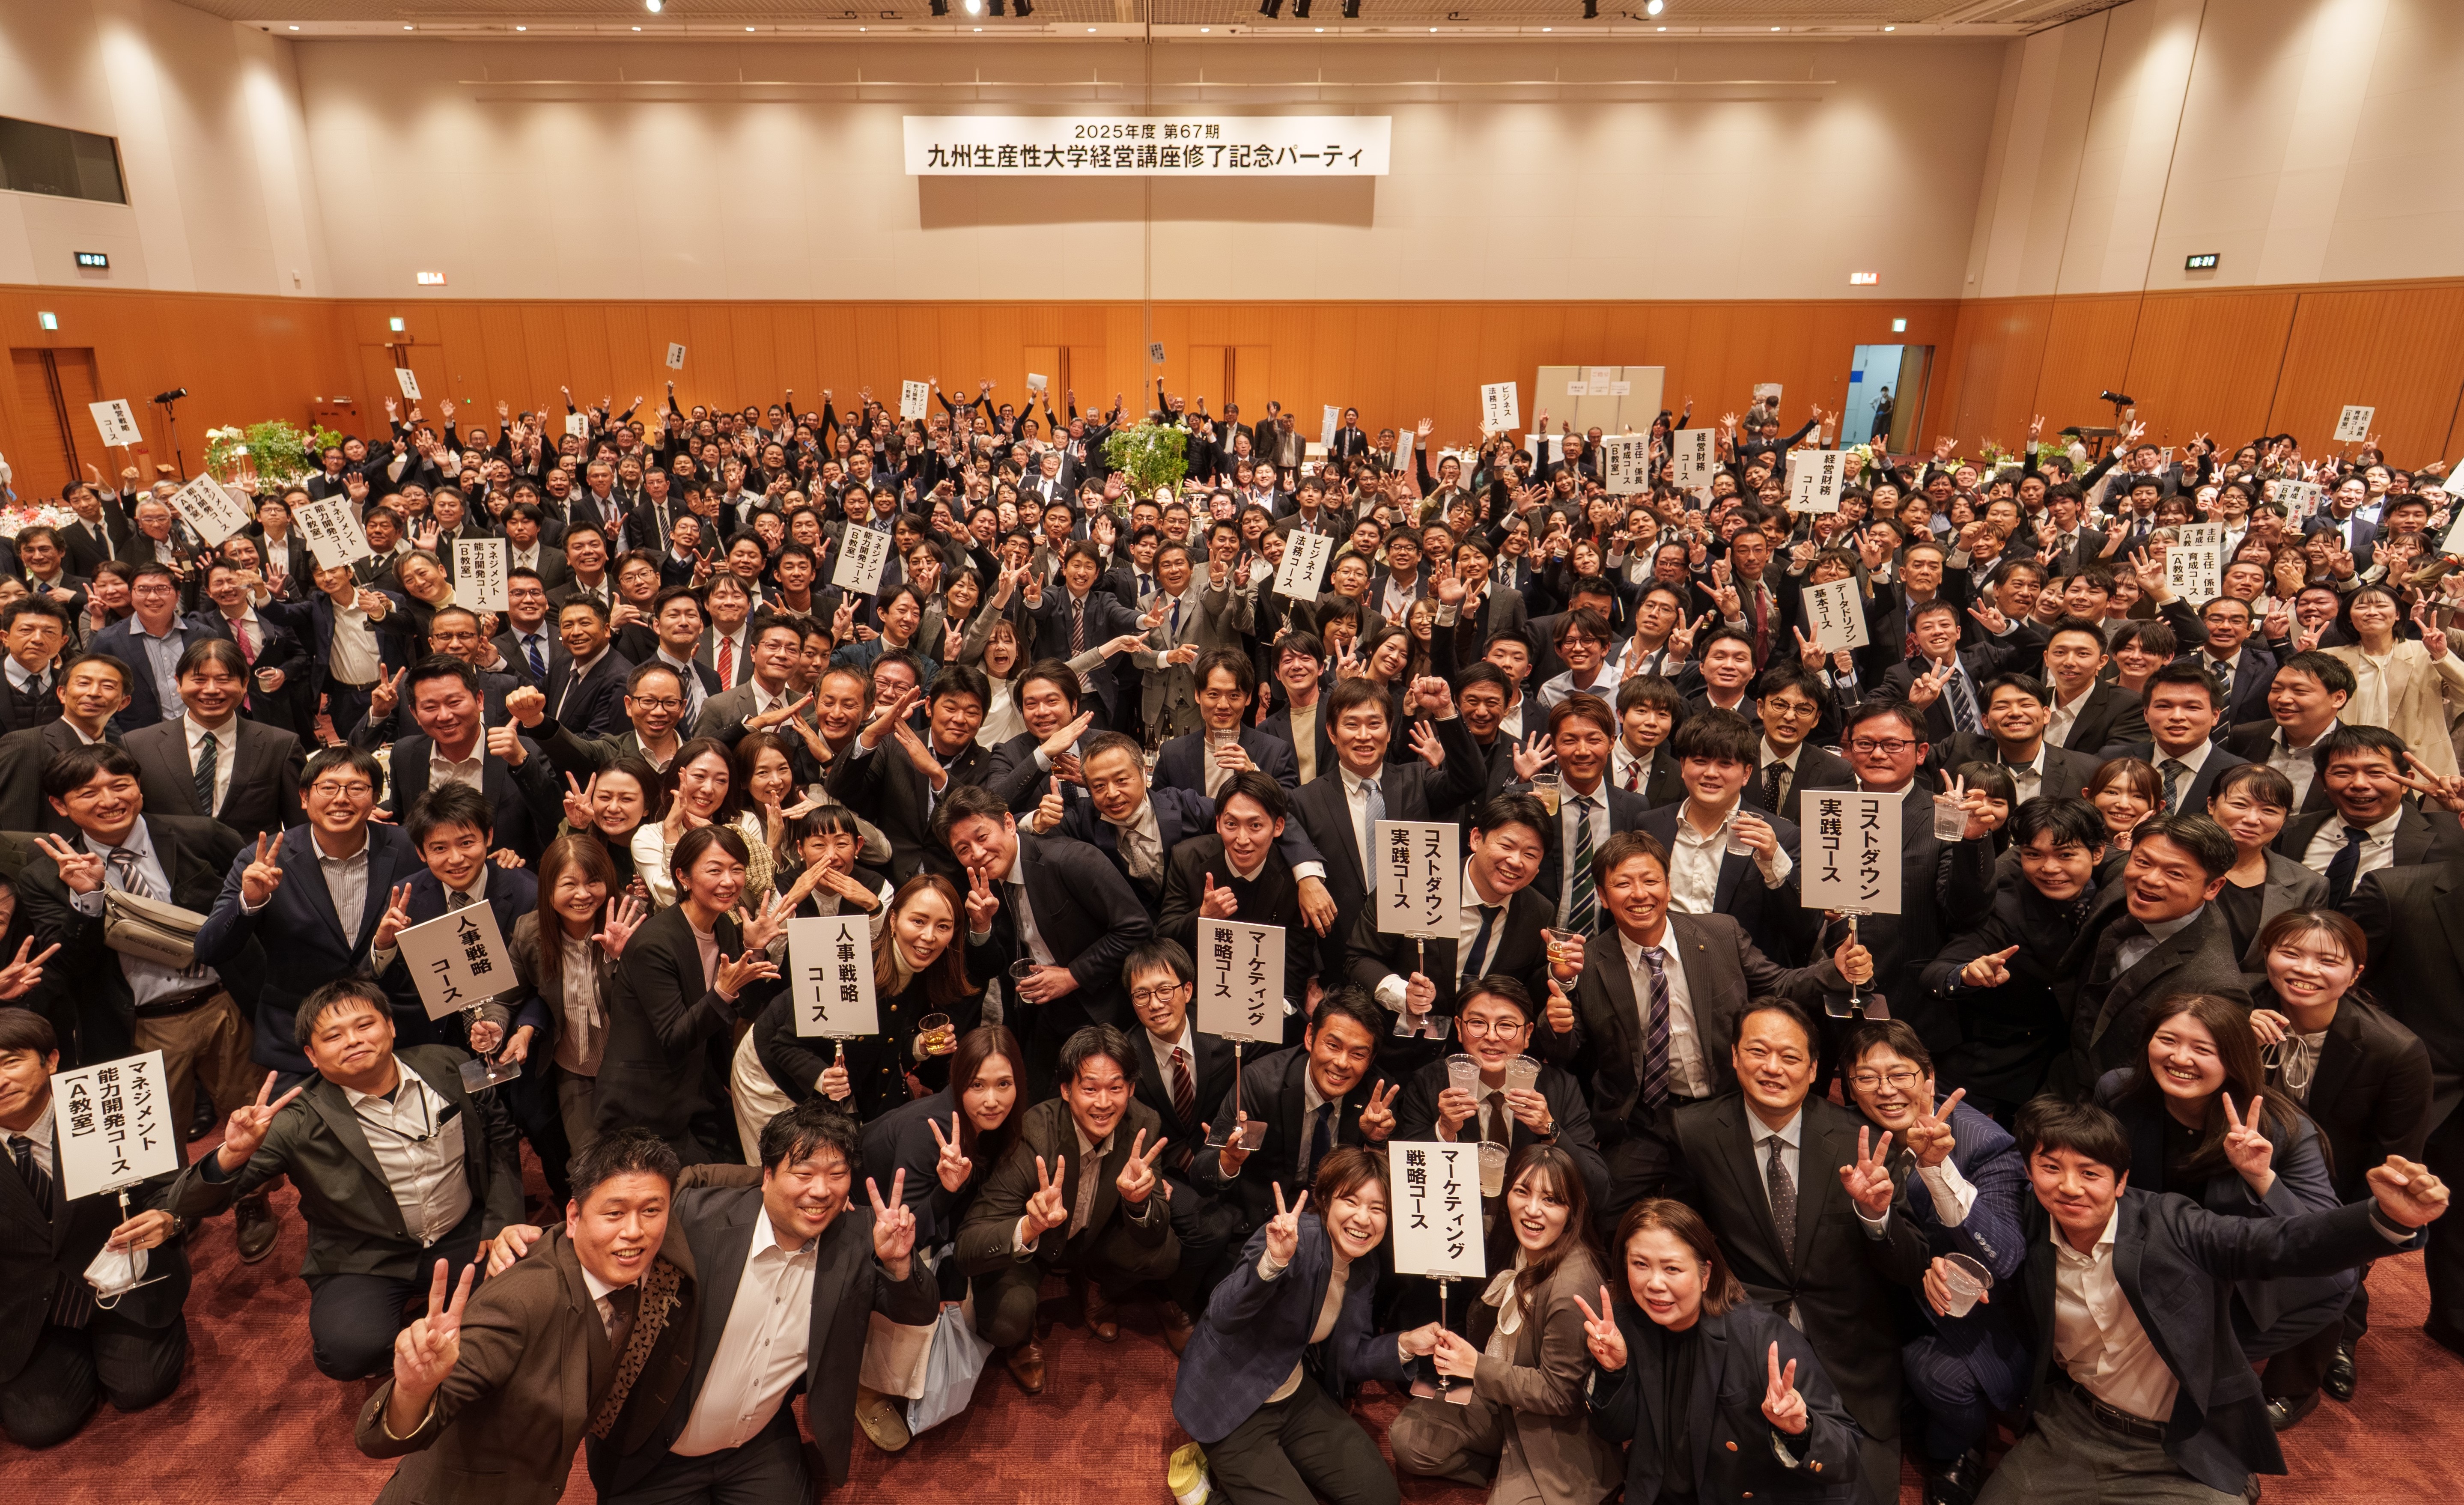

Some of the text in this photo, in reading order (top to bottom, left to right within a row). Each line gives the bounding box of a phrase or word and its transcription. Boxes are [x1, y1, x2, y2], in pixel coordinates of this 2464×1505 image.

[1075, 124, 1219, 139] 2025年度 第67期
[928, 144, 1363, 168] 九州生産性大学経営講座修了記念パーティ
[1489, 387, 1499, 425] 法務コース
[1502, 386, 1511, 416] ビジネス
[104, 420, 119, 440] コース
[1696, 432, 1706, 471] 経営財務
[1611, 444, 1620, 475] 【B教室】
[1623, 443, 1631, 484] 育成コース
[1635, 442, 1643, 484] 主任・係長
[1681, 454, 1689, 480] コース
[1820, 454, 1836, 495] 経営財務
[186, 487, 230, 531] 能力開発コース
[197, 480, 232, 518] マネジメント
[1800, 476, 1812, 504] コース
[300, 509, 324, 540] 【A教室】
[314, 504, 349, 557] 能力開発コース
[328, 501, 357, 545] マネジメント
[845, 527, 861, 558] 【B教室】
[2195, 529, 2204, 546] 育成
[459, 543, 471, 578] 【B教室】
[474, 542, 486, 605] 能力開発コース
[488, 543, 499, 596] マネジメント
[852, 531, 873, 584] 能力開発コース
[867, 535, 884, 580] マネジメント
[1283, 535, 1306, 587] 法務コース
[1303, 539, 1323, 581] ビジネス
[2172, 553, 2184, 585] 【A教室】
[2188, 552, 2199, 595] 育成コース
[2203, 552, 2214, 595] 主任・係長
[1814, 588, 1832, 629] 基本コース
[1835, 583, 1856, 642] データドリブン
[1820, 799, 1842, 882] 実践コース
[1859, 799, 1880, 900] コストダウン
[1391, 828, 1410, 909] 実践コース
[1424, 829, 1443, 926] コストダウン
[457, 915, 493, 977] 人事戦略
[835, 923, 859, 1003] 人事戦略
[1214, 927, 1233, 998] 戦略コース
[432, 959, 462, 1003] コース
[809, 967, 828, 1022] コース
[1248, 931, 1266, 1026] マーケティング
[65, 1075, 95, 1137] 【A教室】
[97, 1067, 131, 1175] 能力開発コース
[128, 1061, 157, 1150] マネジメント
[1406, 1150, 1429, 1229] 戦略コース
[1441, 1150, 1465, 1259] マーケティング
